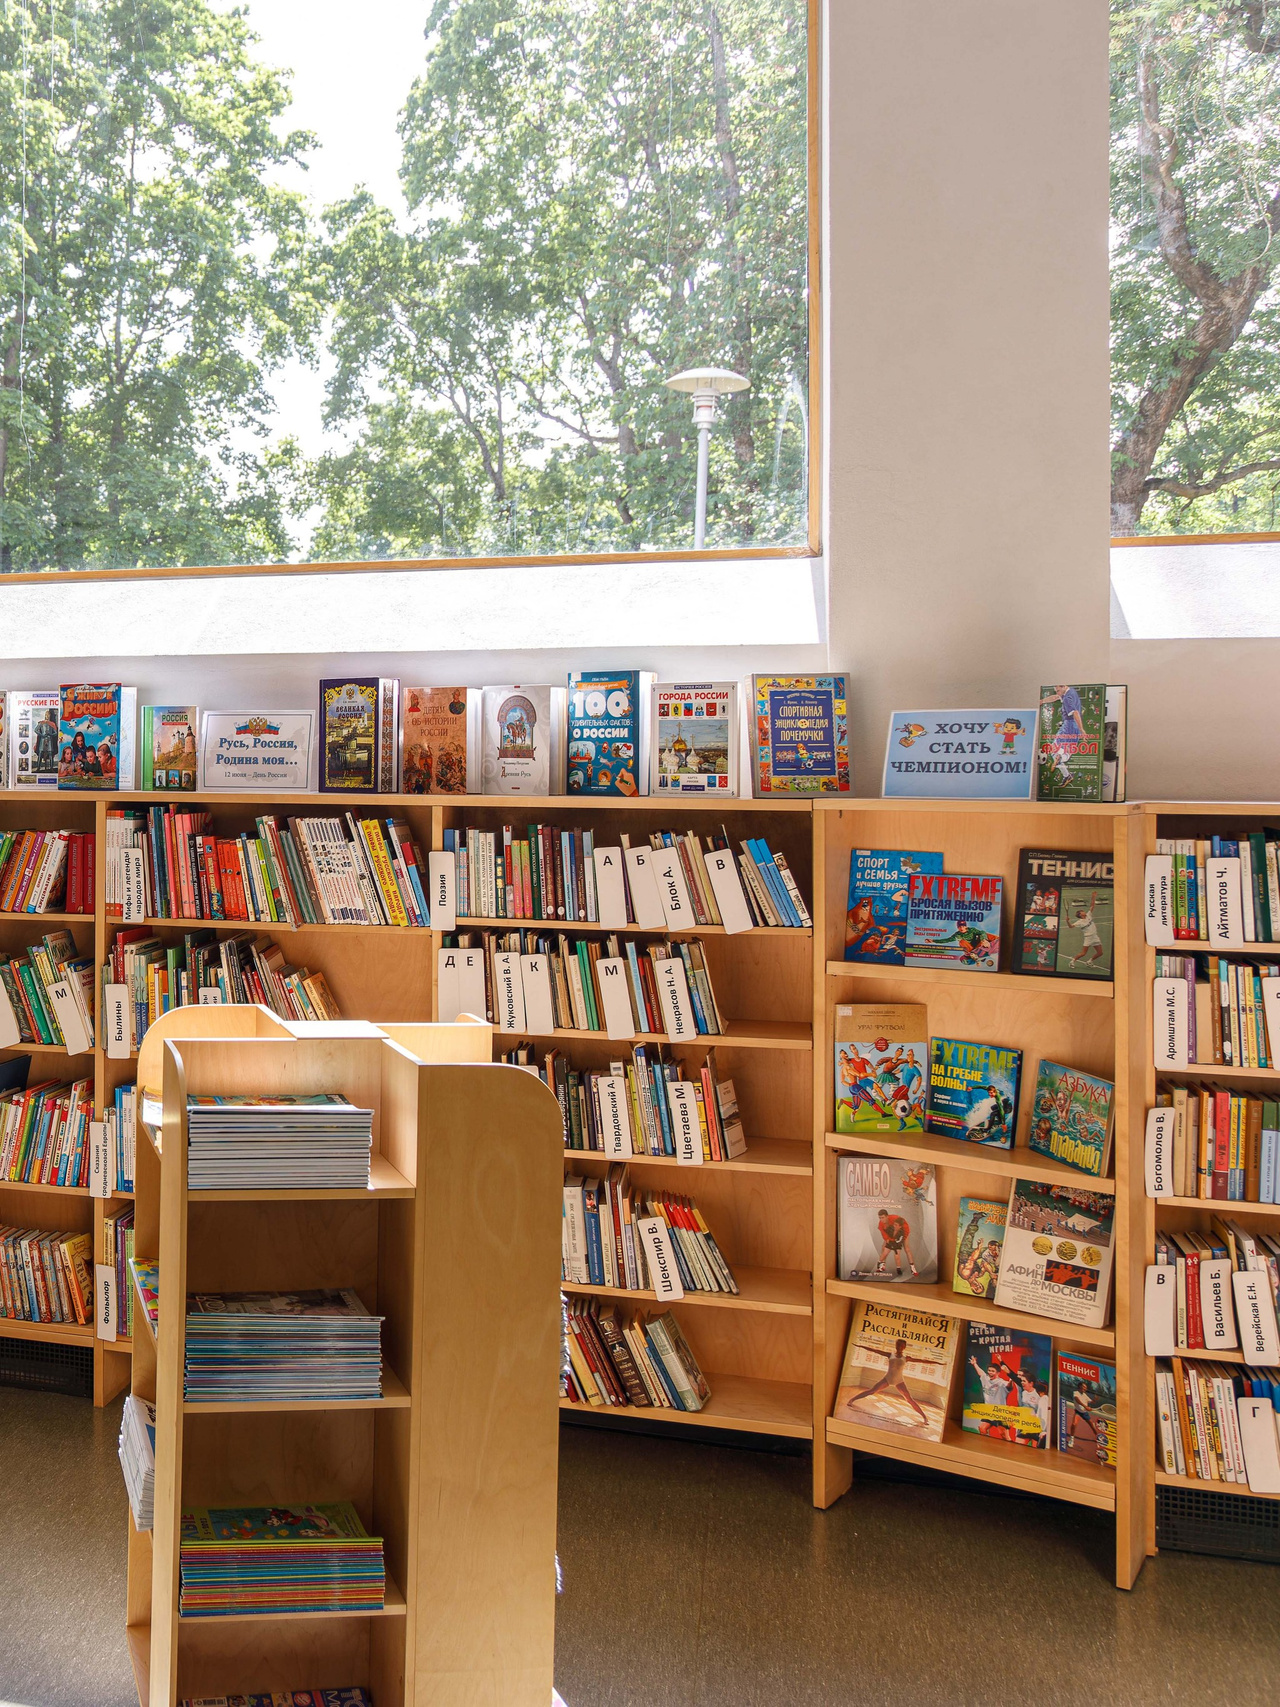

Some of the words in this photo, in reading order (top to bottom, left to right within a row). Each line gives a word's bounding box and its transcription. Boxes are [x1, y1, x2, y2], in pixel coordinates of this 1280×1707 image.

[658, 692, 692, 701] ГОРОДА
[695, 692, 728, 700] РОССИИ
[63, 702, 117, 717] РОССИИ!
[422, 706, 445, 715] ДЕТЯМ
[572, 692, 629, 718] 100
[779, 706, 822, 717] СПОРТИВНАЯ
[162, 714, 188, 722] РОССИЯ
[412, 717, 422, 726] ОБ
[424, 716, 457, 726] ИСТОРИИ
[571, 719, 609, 728] УДИВИТЕЛЬНЫХ
[774, 718, 828, 729] ЭНЦИКЛОПЕДИЯ
[420, 728, 448, 737] РОССИИ
[573, 729, 580, 738] О
[583, 728, 628, 738] РОССИИ
[934, 722, 990, 734] ХОЧУ
[780, 730, 824, 741] ПОЧЕМУЧКИ
[219, 738, 249, 750] Русь,
[252, 738, 298, 750] Россия,
[929, 742, 991, 754] СТАТЬ
[1042, 742, 1098, 754] ФУТБОЛ
[216, 754, 259, 766] Родина
[891, 760, 1027, 774] ЧЕМПИОНОМ!
[603, 856, 612, 866] А
[636, 854, 646, 866] Б
[716, 859, 726, 870] В
[857, 857, 890, 869] СПОРТ
[662, 866, 672, 878] А.
[864, 870, 898, 880] СЕМЬЯ
[1028, 858, 1114, 880] ТЕННИС
[1216, 867, 1228, 879] Ч.
[438, 874, 446, 907] Поэзия
[856, 880, 880, 889] лучшие
[882, 882, 908, 892] друзья
[910, 876, 1002, 902] EXTREME
[667, 880, 681, 911] Блок
[1148, 883, 1156, 918] Русская
[1160, 875, 1168, 926] литература
[910, 898, 952, 910] БРОСАЯ
[954, 900, 992, 912] ВЫЗОВ
[910, 908, 984, 923] ПРИТЯЖЕНИЮ
[1218, 886, 1230, 940] Айтматов
[445, 956, 456, 968] Д
[466, 956, 474, 967] Е
[502, 954, 510, 964] А.
[504, 966, 510, 975] В.
[530, 961, 539, 972] К
[604, 965, 619, 976] М
[666, 965, 674, 976] А.
[668, 976, 676, 988] Н.
[54, 988, 68, 1000] М
[1166, 986, 1176, 1008] М.С.
[506, 976, 515, 1029] Жуковский
[672, 988, 684, 1036] Некрасов
[114, 1000, 122, 1042] Былины
[1166, 1008, 1176, 1060] Аромштам
[932, 1040, 1017, 1078] EXTREME
[932, 1064, 945, 1075] НА
[947, 1066, 983, 1082] ГРЕБНЕ
[606, 1080, 616, 1090] А.
[930, 1075, 967, 1091] ВОЛНЫ
[1058, 1072, 1108, 1104] АЗБУКА
[676, 1084, 684, 1099] М.
[612, 1091, 622, 1154] Твардовский
[1156, 1112, 1166, 1123] В.
[682, 1102, 694, 1160] Цветаева
[1154, 1124, 1164, 1192] Богомолов
[846, 1160, 891, 1198] САМБО
[647, 1222, 656, 1234] В.
[652, 1237, 672, 1294] Шекспир
[1006, 1264, 1044, 1280] АФИН
[1210, 1269, 1222, 1284] Б.
[1157, 1274, 1166, 1284] В
[1041, 1281, 1097, 1302] МОСКВЫ
[1247, 1282, 1258, 1302] Е.Н.
[864, 1304, 950, 1332] РАСТЯГИВАЙСЯ
[1215, 1286, 1226, 1338] Васильев
[970, 1327, 996, 1336] РЕГБИ
[1252, 1302, 1264, 1352] Верейская
[860, 1320, 946, 1350] РАССЛАБЛЯЙСЯ
[979, 1335, 1011, 1344] КРУТАЯ
[989, 1344, 1014, 1354] ИГРА!
[1062, 1361, 1096, 1378] ТЕННИС
[992, 1405, 1020, 1418] Детская
[1252, 1406, 1260, 1418] Г
[970, 1408, 1020, 1425] энциклопедия
[1020, 1418, 1042, 1430] регби
